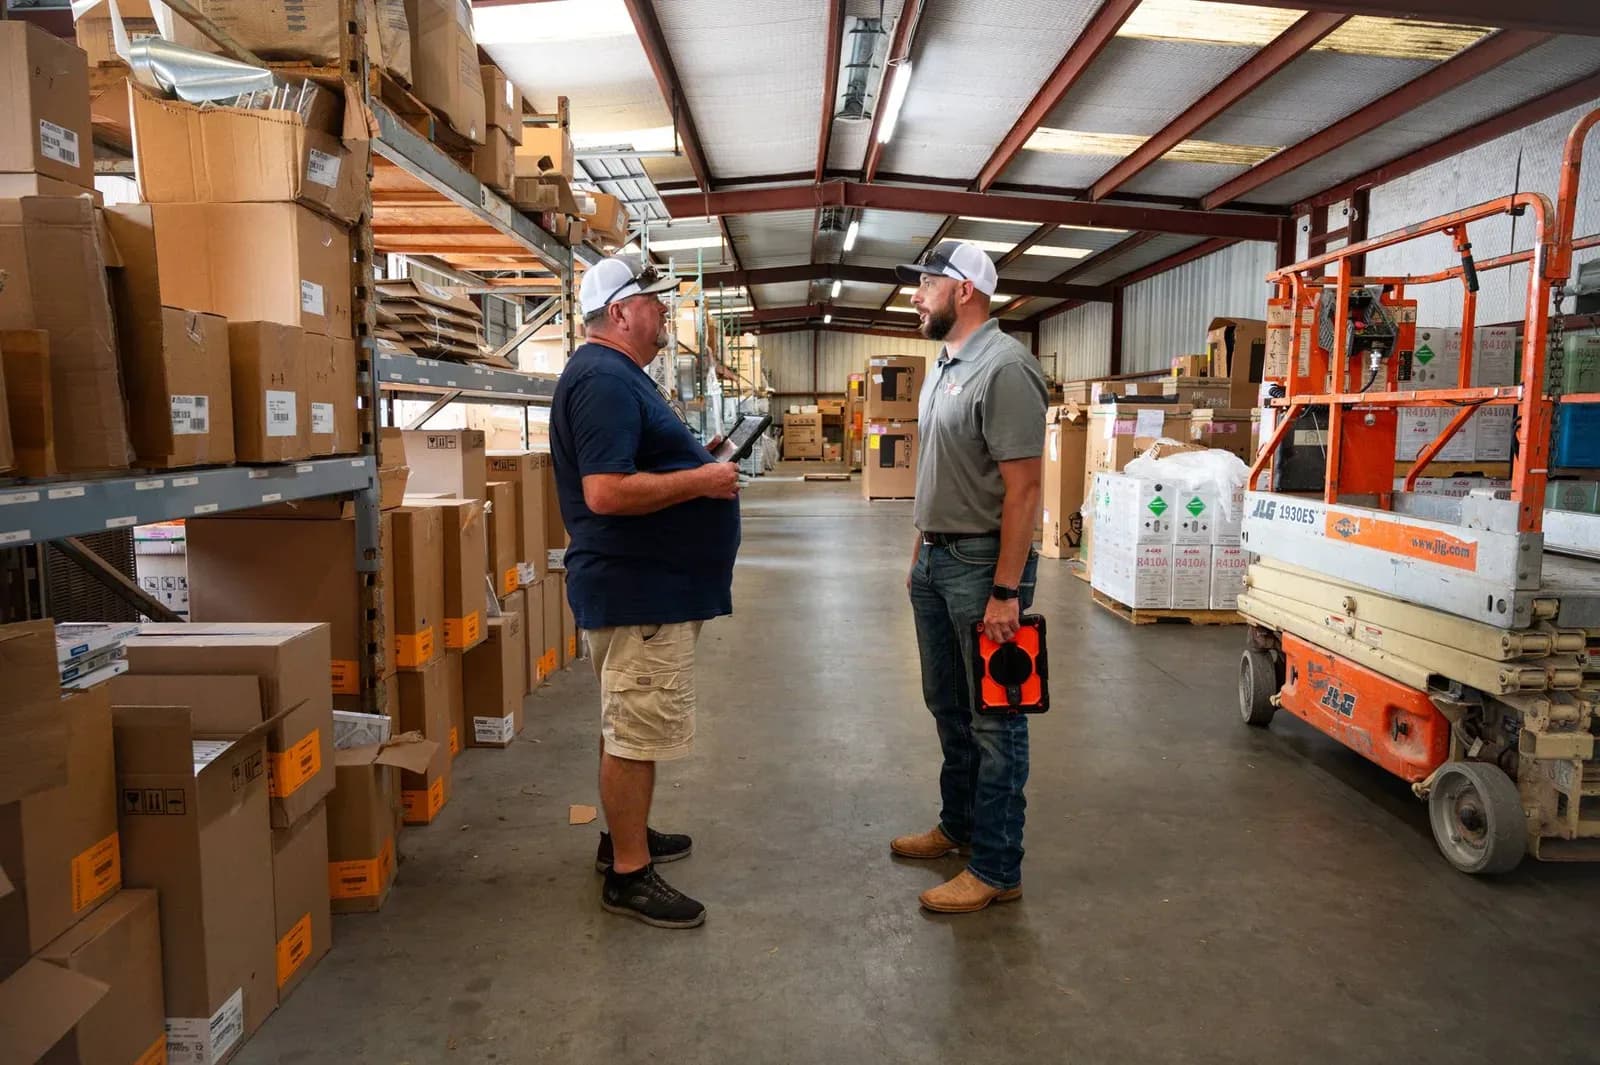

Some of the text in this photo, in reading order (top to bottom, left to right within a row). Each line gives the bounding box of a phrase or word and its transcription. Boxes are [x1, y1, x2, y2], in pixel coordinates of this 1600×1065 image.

[1482, 340, 1513, 351] R410A
[1406, 407, 1437, 418] R410A
[1480, 407, 1511, 417] R410A
[1252, 499, 1315, 525] JLG 1930ES
[1411, 537, 1470, 558] www.jlg.com
[1137, 557, 1169, 567] R410A
[1175, 558, 1206, 568] R410A
[1216, 559, 1247, 568] R410A
[1321, 685, 1356, 717] JLG
